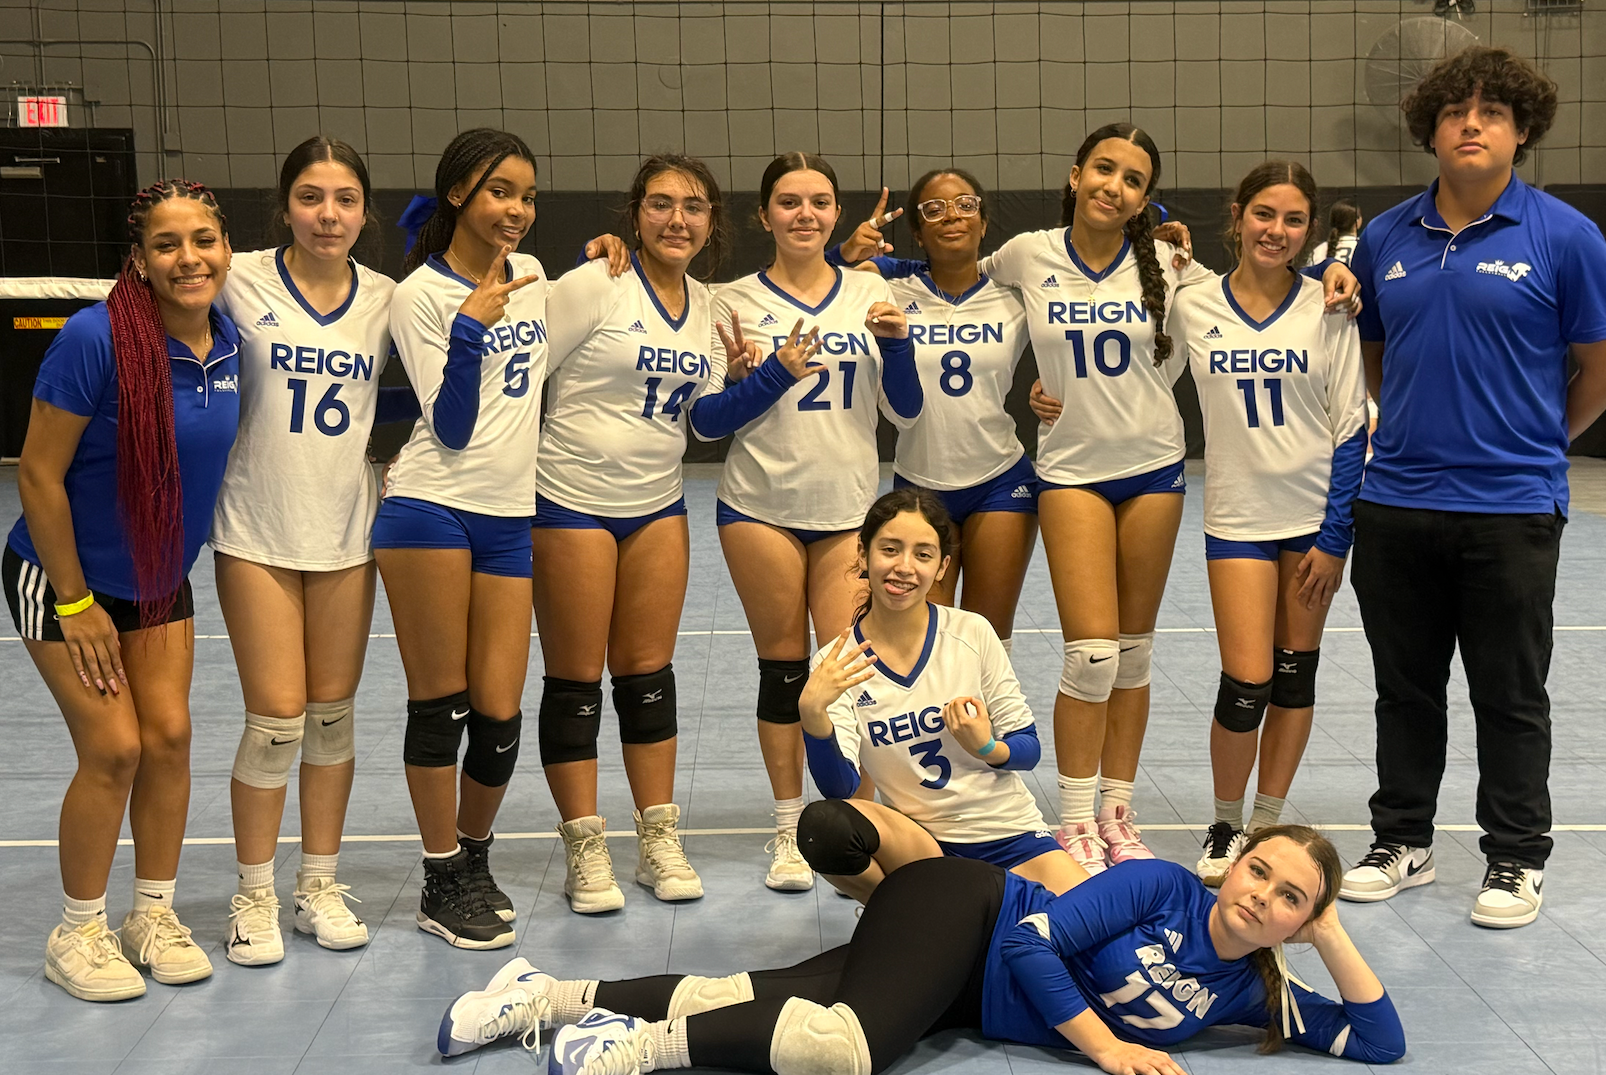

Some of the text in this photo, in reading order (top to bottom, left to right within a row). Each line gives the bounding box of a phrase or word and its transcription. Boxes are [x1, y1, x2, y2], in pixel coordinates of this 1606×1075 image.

[27, 98, 59, 124] EXIT
[14, 318, 42, 328] CAUTION
[909, 323, 1003, 345] REIGN
[1048, 301, 1147, 324] REIGN
[482, 319, 549, 357] REIGN
[1065, 330, 1131, 379] 10
[271, 342, 375, 381] REIGN
[502, 352, 531, 398] 5
[636, 345, 712, 380] REIGN
[939, 350, 974, 397] 8
[1209, 349, 1308, 374] REIGN
[287, 378, 351, 437] 16
[641, 377, 697, 422] 14
[798, 361, 857, 411] 21
[1236, 378, 1285, 428] 11
[867, 702, 949, 747] REIG
[908, 738, 952, 790] 3
[1100, 970, 1186, 1030] 17
[1134, 944, 1219, 1020] REIGN
